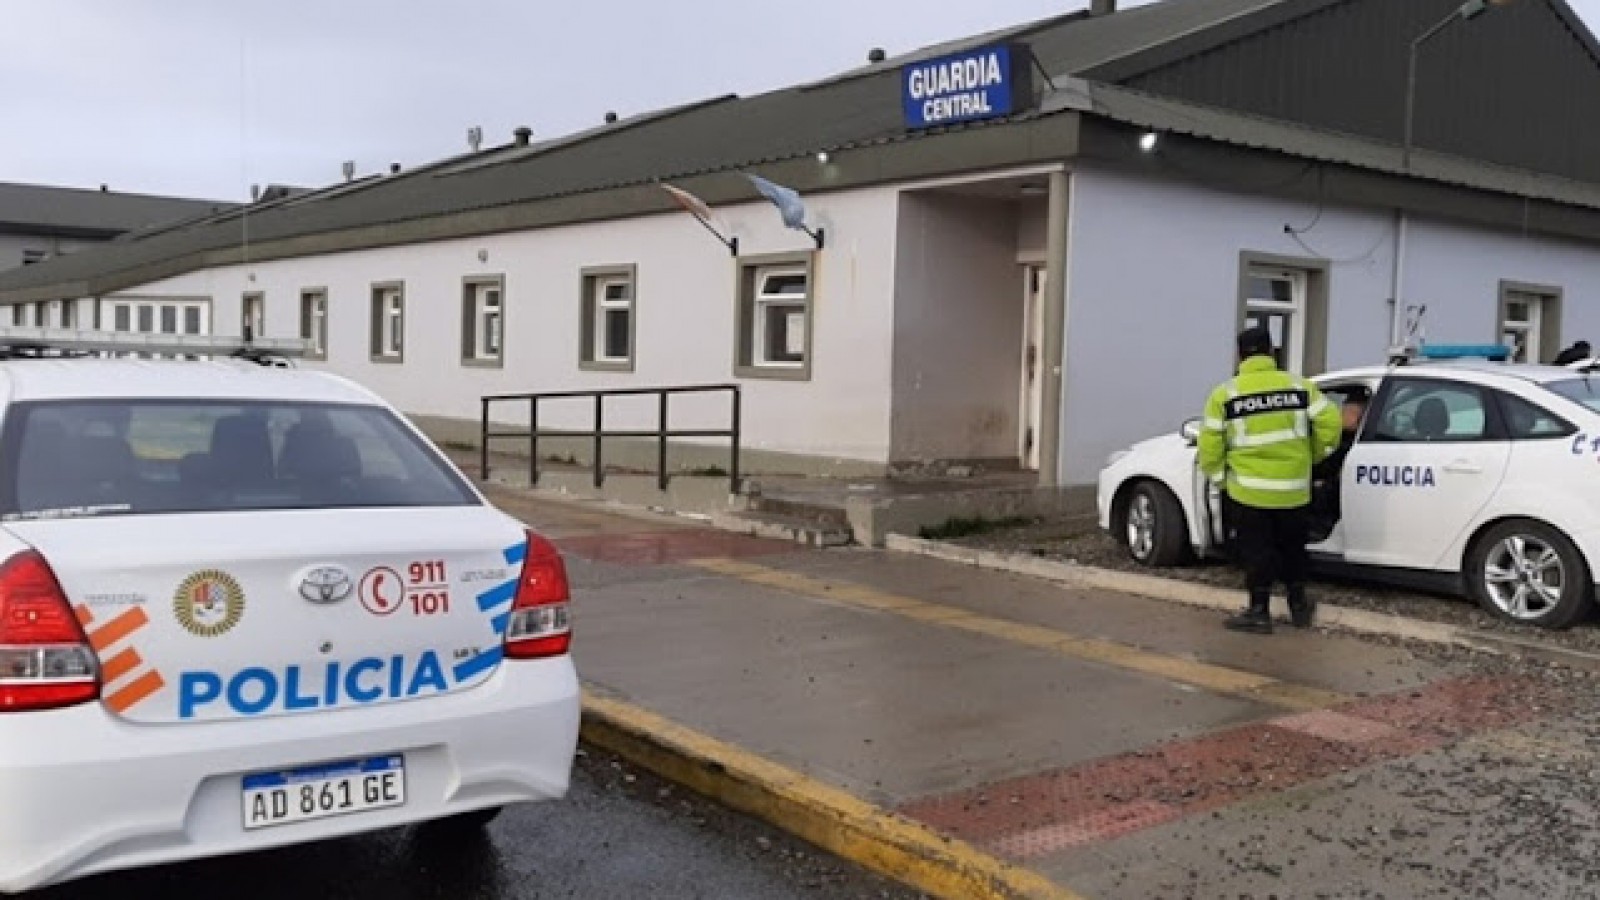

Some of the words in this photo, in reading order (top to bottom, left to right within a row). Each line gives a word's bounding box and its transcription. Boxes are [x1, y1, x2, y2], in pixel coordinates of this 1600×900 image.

[909, 52, 1002, 98] GUARDIA
[923, 90, 992, 121] CENTRAL
[1233, 393, 1300, 414] POLICIA
[1356, 466, 1435, 486] POLICIA
[409, 560, 444, 584] 911
[409, 592, 449, 615] 101
[179, 650, 448, 718] POLICIA
[253, 790, 288, 822] AD
[300, 779, 353, 813] 861
[363, 772, 397, 802] GE
